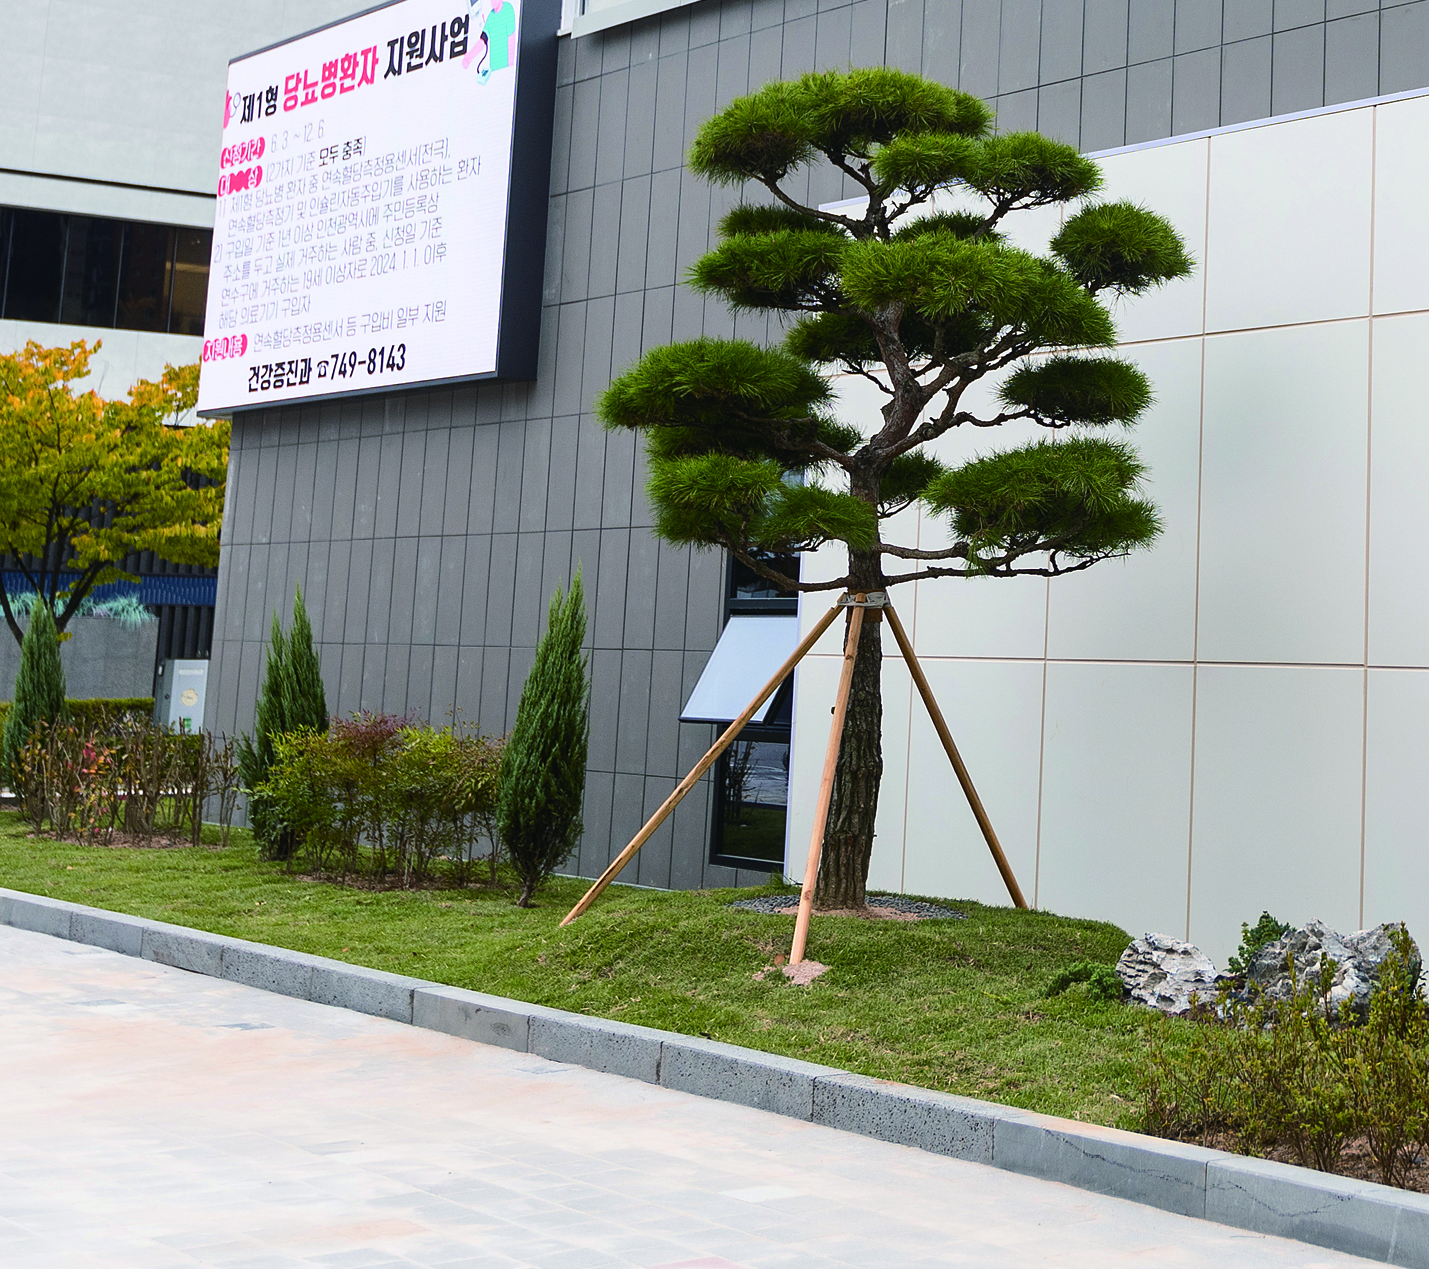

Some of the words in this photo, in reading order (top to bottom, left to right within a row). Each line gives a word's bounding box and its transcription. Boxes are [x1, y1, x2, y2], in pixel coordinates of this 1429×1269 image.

[240, 85, 278, 124] 제1형
[283, 45, 379, 112] 당뇨병환자
[384, 14, 470, 79] 지원사업
[298, 151, 315, 171] 기준
[319, 144, 338, 167] 모두
[229, 204, 294, 238] 연속혈당측정기
[297, 201, 307, 219] 및
[310, 175, 403, 217] 인슐린자동주입기를
[407, 164, 452, 191] 사용하는
[457, 155, 481, 180] 환자
[256, 185, 283, 208] 당뇨병
[287, 178, 305, 200] 환자
[309, 174, 318, 194] 중
[224, 260, 250, 283] 주소를
[254, 255, 273, 276] 두고
[276, 250, 295, 272] 실제
[298, 241, 338, 266] 거주하는
[341, 235, 362, 257] 사람
[383, 222, 416, 249] 신청일
[420, 217, 442, 240] 기준
[226, 238, 253, 259] 구입일
[257, 232, 274, 251] 기준
[279, 228, 291, 248] 1년
[294, 222, 313, 244] 이상
[317, 206, 379, 239] 인천광역시에
[383, 192, 439, 222] 주민등록상
[221, 282, 258, 307] 연수구에
[261, 274, 299, 297] 거주하는
[303, 268, 322, 290] 19세
[325, 258, 367, 285] 이상자로
[424, 241, 447, 263] 이후
[219, 309, 238, 329] 해당
[240, 301, 278, 325] 의료기기
[281, 294, 311, 318] 구입자
[253, 318, 343, 353] 연속혈당측정용센서
[346, 316, 356, 337] 등
[361, 310, 393, 334] 구입비
[397, 305, 419, 329] 일부
[422, 300, 447, 323] 지원
[248, 357, 312, 393] 건강증진과
[330, 343, 406, 380] 749-8143
